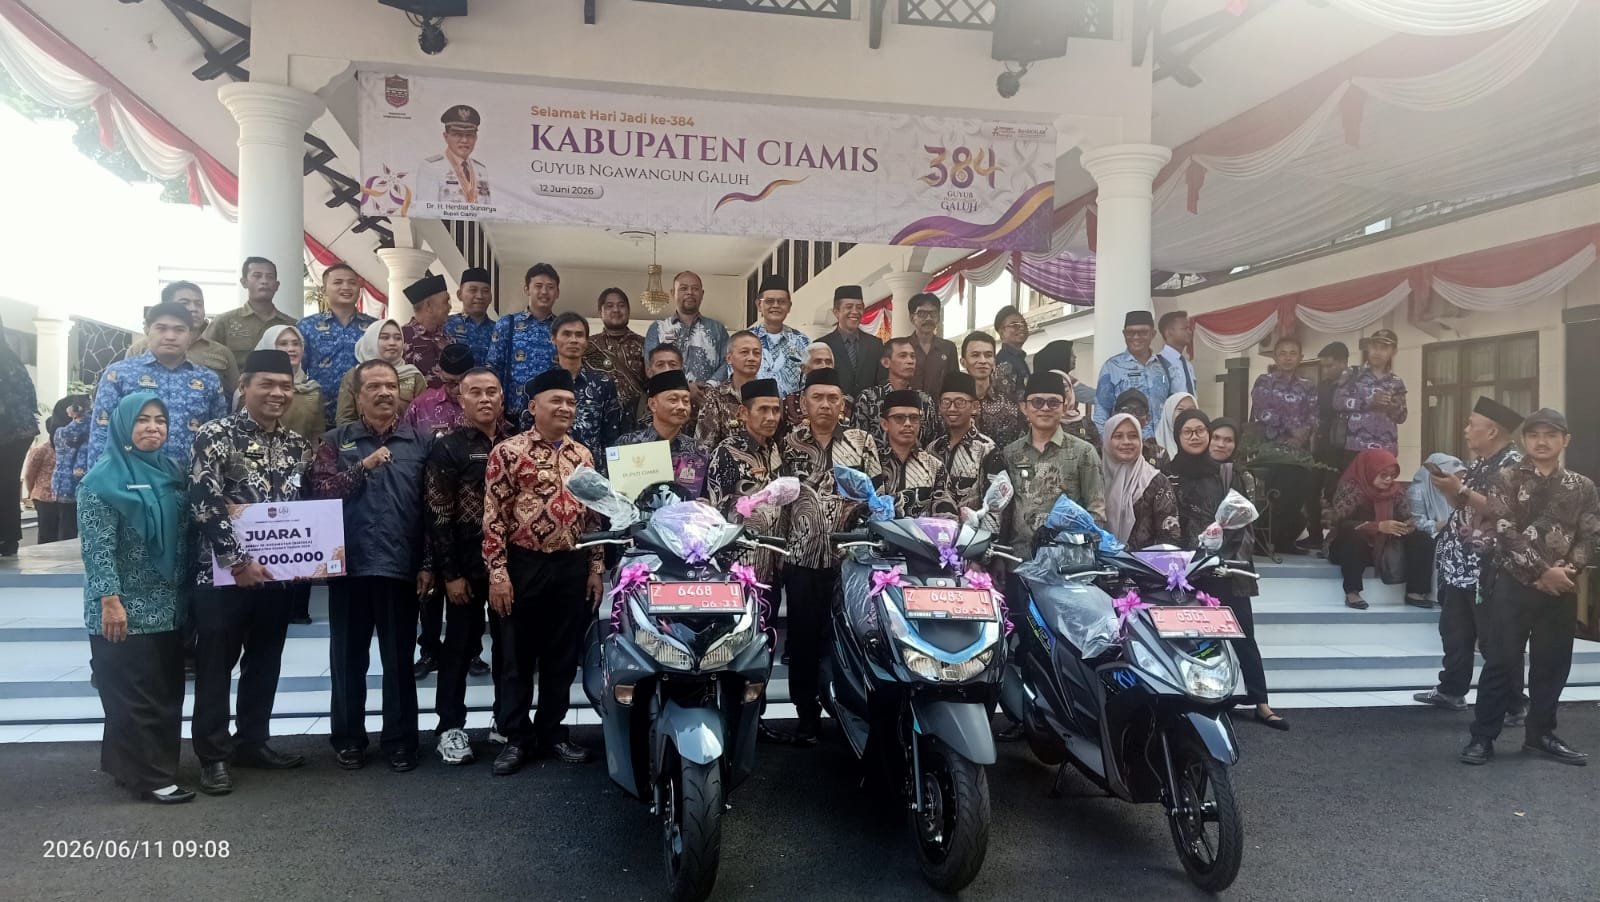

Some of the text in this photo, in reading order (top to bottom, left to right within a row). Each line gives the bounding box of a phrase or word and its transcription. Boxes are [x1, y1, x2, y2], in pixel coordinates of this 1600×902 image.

[531, 106, 695, 127] Selamat Hari Jadi ke-384
[531, 124, 878, 173] KABUPATEN CIAMIS
[531, 160, 750, 185] GUYUB NGAWANGUN GALUH
[917, 144, 1004, 189] 384
[539, 184, 594, 195] 12 Juni 2026
[245, 527, 311, 542] JUARA 1
[678, 585, 713, 597] 6468
